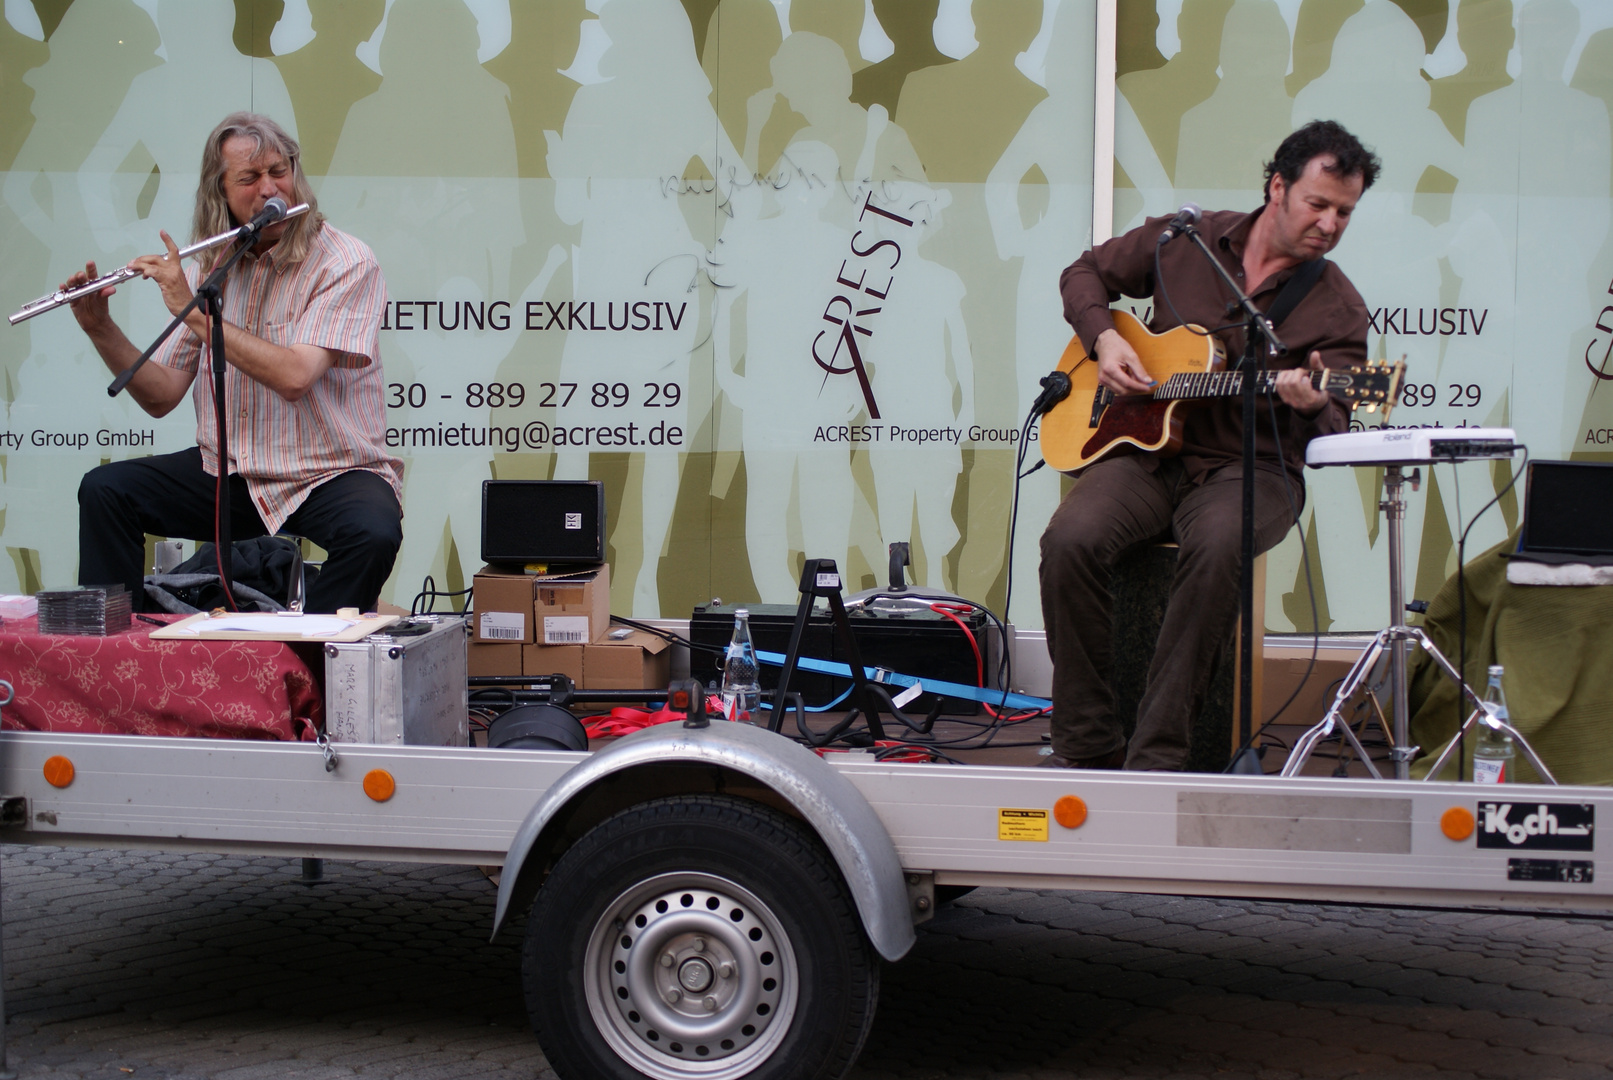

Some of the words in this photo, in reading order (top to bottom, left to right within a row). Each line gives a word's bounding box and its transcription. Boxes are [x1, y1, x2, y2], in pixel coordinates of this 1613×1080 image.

[525, 300, 687, 331] EXKLUSIV
[465, 383, 525, 408] 889
[539, 383, 578, 408] 27
[590, 383, 630, 408] 89
[643, 383, 682, 408] 29
[1402, 383, 1437, 408] 89
[1448, 383, 1482, 408] 29
[31, 429, 89, 450] Group
[96, 428, 154, 446] GmbH
[813, 425, 884, 442] ACREST
[890, 425, 962, 445] Property
[968, 425, 1020, 445] Group
[1484, 803, 1559, 845] Koch
[1560, 867, 1583, 883] 1,5
